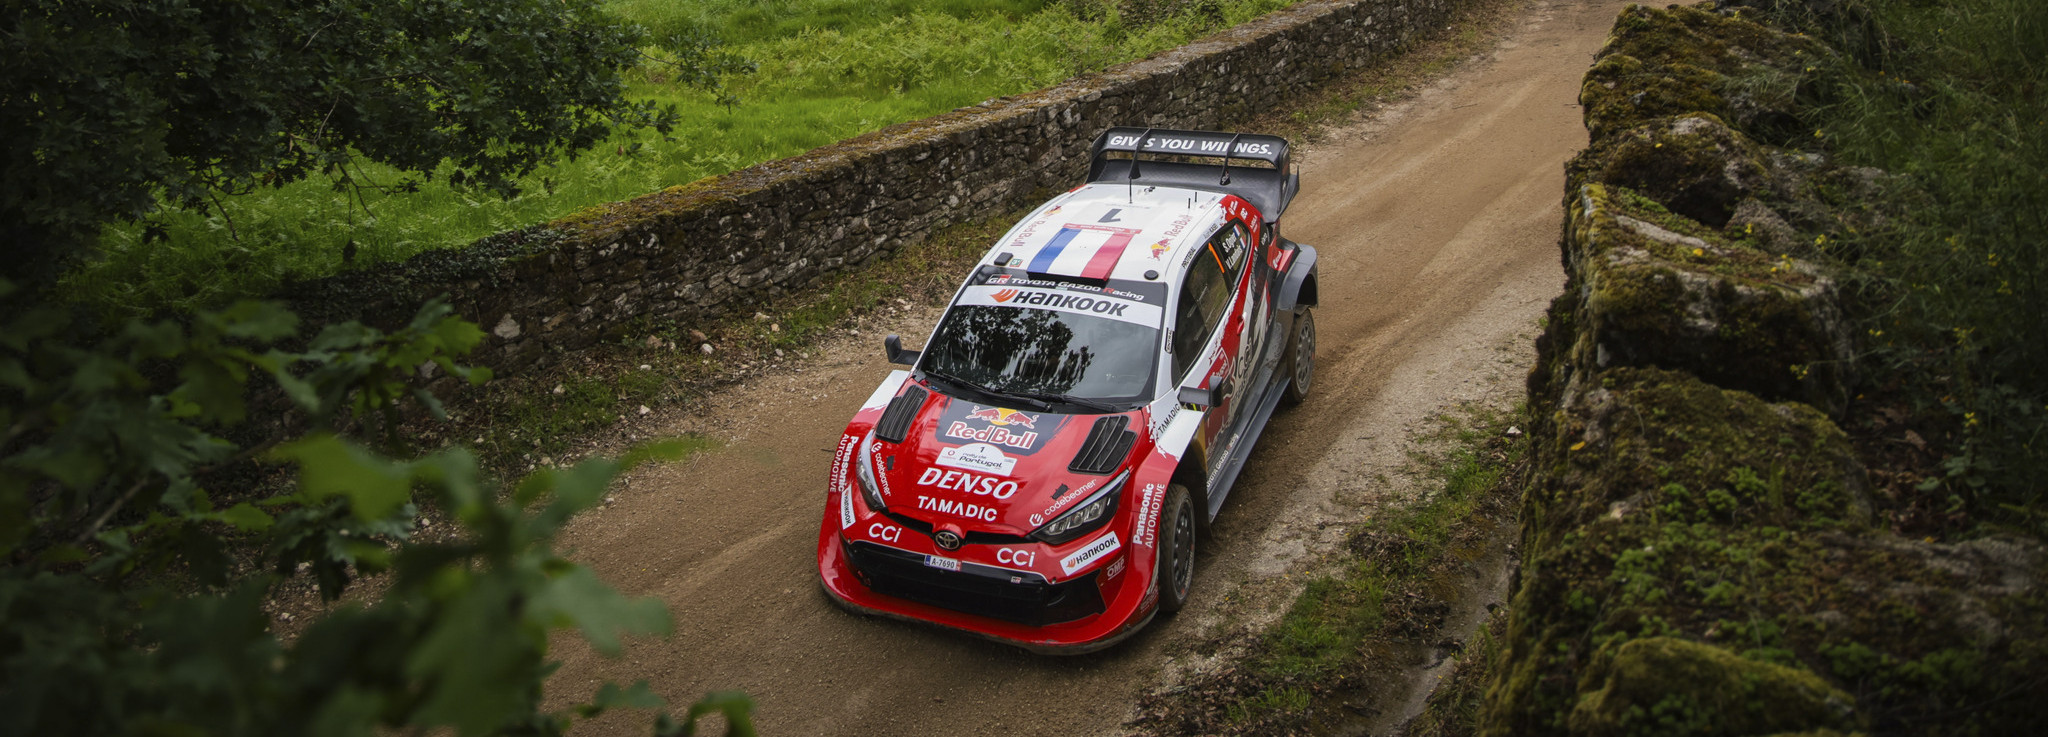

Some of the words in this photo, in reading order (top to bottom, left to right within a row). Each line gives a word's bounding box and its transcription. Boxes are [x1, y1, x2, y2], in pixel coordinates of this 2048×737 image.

[1109, 135, 1156, 148] GIVS
[1160, 138, 1196, 150] YOU
[1011, 278, 1057, 287] TOYOTA
[1057, 281, 1101, 292] GAZOO
[1102, 287, 1145, 301] Racing
[1158, 403, 1180, 434] TAMADIC
[945, 421, 995, 442] Red
[989, 427, 1038, 449] Bull
[829, 433, 849, 493] AUTOMOTIVE
[838, 435, 859, 492] Panasonic
[959, 456, 1002, 467] Portugal
[917, 467, 1018, 499] DENSO
[1044, 479, 1097, 516] codebeamer
[917, 495, 997, 521] TAMADIC
[1132, 483, 1155, 545] Panasonic
[1144, 483, 1166, 549] AUTOMOTIVE
[931, 557, 955, 569] A-7690
[1107, 559, 1125, 577] OMP
